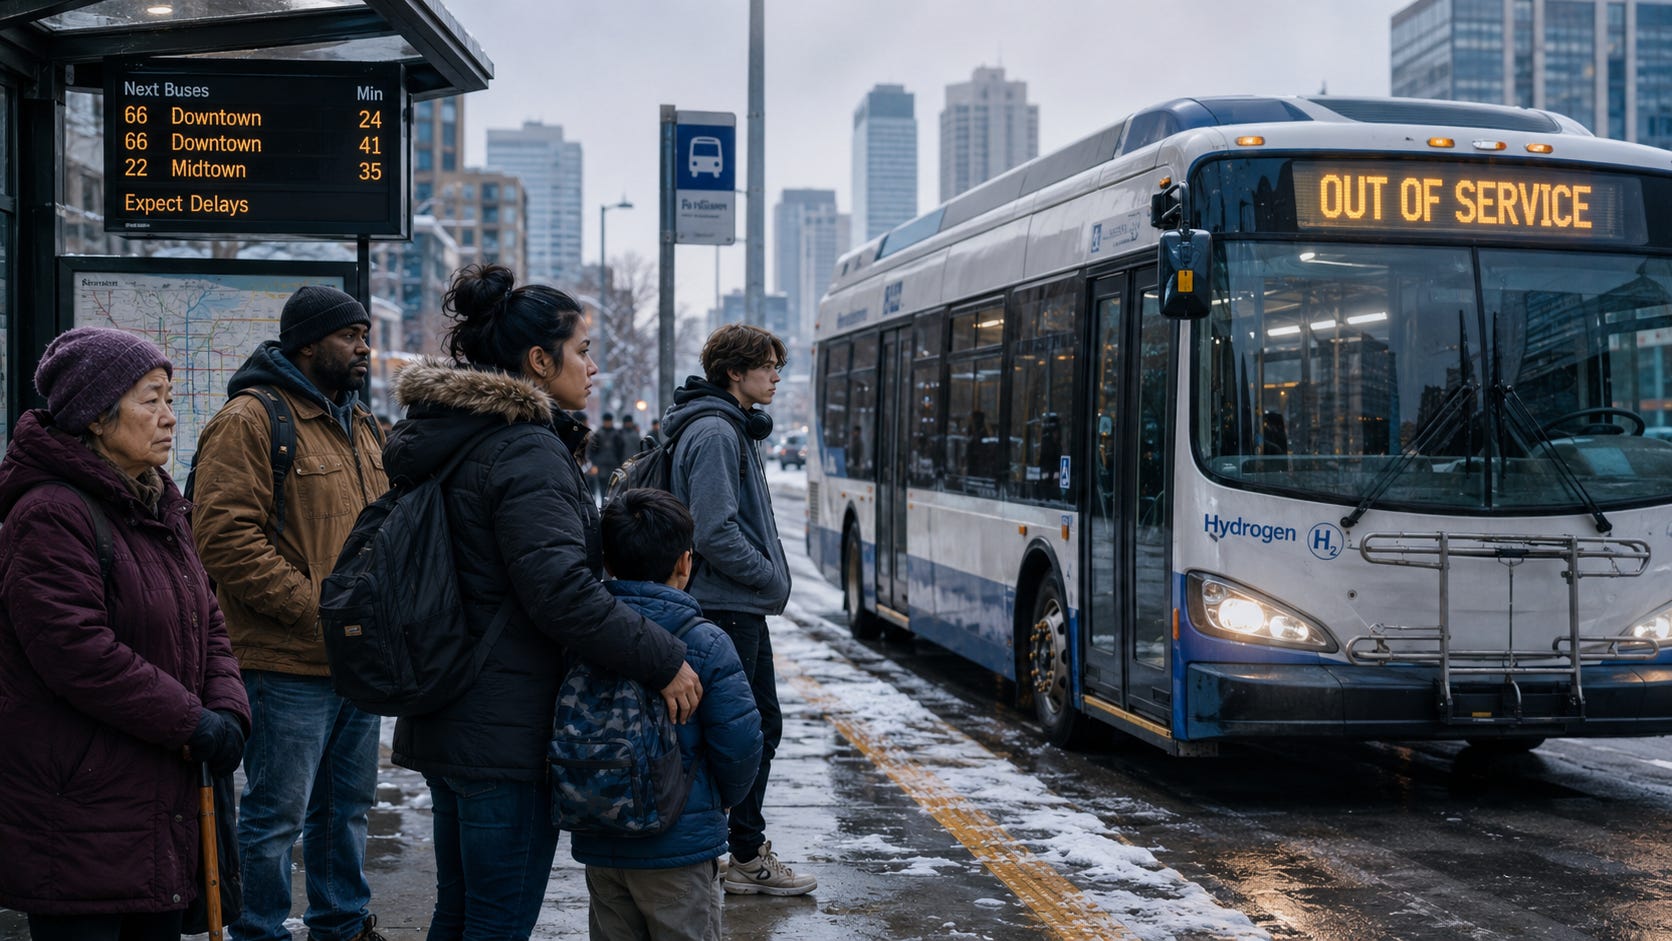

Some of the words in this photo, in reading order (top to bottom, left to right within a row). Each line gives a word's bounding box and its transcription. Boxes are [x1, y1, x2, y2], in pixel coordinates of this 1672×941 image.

[124, 81, 160, 97] Next
[164, 82, 210, 98] Buses
[356, 86, 383, 101] Min
[124, 105, 148, 124] 66
[171, 106, 262, 126] Downtown
[358, 110, 382, 129] 24
[124, 132, 148, 151] 66
[171, 132, 262, 152] Downtown
[358, 136, 382, 155] 41
[124, 158, 148, 177] 22
[171, 159, 247, 178] Midtown
[358, 162, 382, 180] 35
[125, 193, 184, 216] Expect
[190, 194, 249, 216] Delays
[1320, 174, 1388, 220] OUT
[1400, 177, 1443, 222] OF
[1455, 180, 1593, 228] SERVICE
[1203, 513, 1297, 544] Hydrogen
